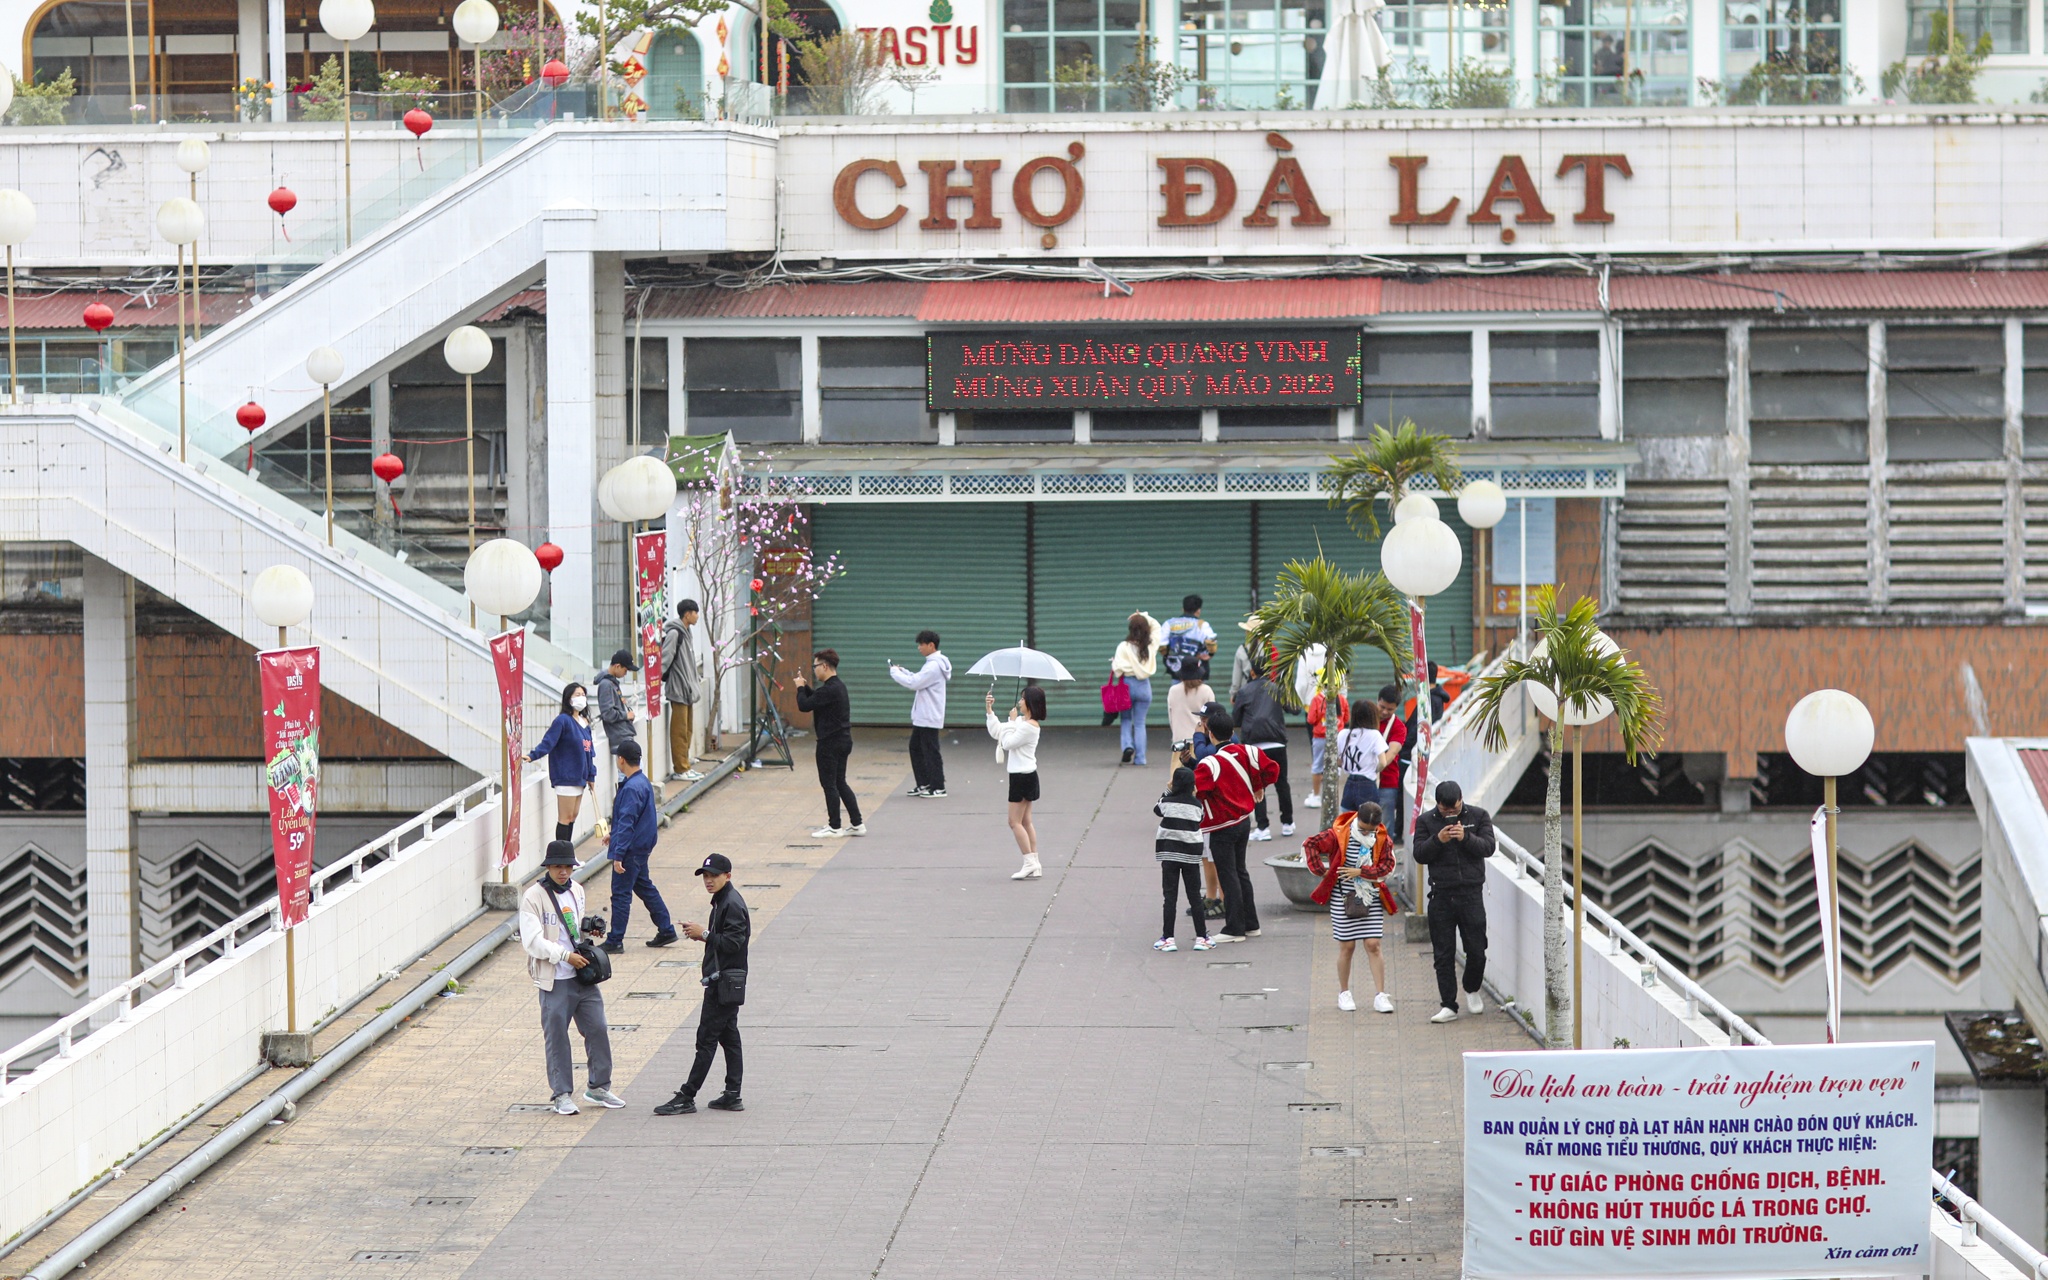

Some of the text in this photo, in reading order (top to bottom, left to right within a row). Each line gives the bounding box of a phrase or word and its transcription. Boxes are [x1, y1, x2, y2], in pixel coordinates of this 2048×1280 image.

[857, 25, 977, 66] TASTY
[833, 132, 1634, 249] CHỢ ĐÀ LẠT
[1147, 342, 1249, 370] QUANG
[1255, 341, 1328, 363] VINH
[1049, 371, 1131, 397] XUÂN
[1205, 369, 1272, 395] MÃO
[1278, 374, 1335, 395] 2023
[286, 675, 302, 687] TASTY
[1483, 1069, 1536, 1098] "Du
[1539, 1074, 1576, 1103] lịch
[1581, 1084, 1612, 1097] an
[1617, 1076, 1665, 1097] toàn
[1688, 1073, 1730, 1096] trải
[1733, 1070, 1815, 1109] nghiệm
[1819, 1076, 1866, 1098] trọn
[1483, 1112, 1918, 1138] BAN QUẢN LÝ CHỢ ĐÀ LẠT HÂN HẠNH CHÀO ĐÓN QUÝ KHÁCH.
[1525, 1134, 1876, 1157] RẤT MONG TIỂU THƯƠNG, QUÝ KHÁCH THỰC HIỆN:
[1529, 1173, 1556, 1195] TỰ
[1560, 1171, 1608, 1192] GIÁC
[1615, 1170, 1684, 1191] PHÒNG
[1691, 1167, 1760, 1191] CHỐNG
[1766, 1171, 1820, 1192] DỊCH,
[1827, 1166, 1886, 1190] BỆNH.
[1529, 1199, 1599, 1219] KHÔNG
[1605, 1199, 1643, 1219] HÚT
[1650, 1195, 1715, 1218] THUỐC
[1721, 1197, 1746, 1218] LÁ
[1752, 1199, 1818, 1217] TRONG
[1825, 1195, 1871, 1217] CHỢ.
[1529, 1226, 1565, 1246] GIỮ
[1569, 1226, 1604, 1246] GÌN
[1611, 1226, 1635, 1250] VỆ
[1642, 1229, 1690, 1246] SINH
[1697, 1225, 1736, 1245] MÔI
[1743, 1222, 1828, 1244] TRƯỜNG.
[1825, 1243, 1919, 1260] Xin cảm ơn!
